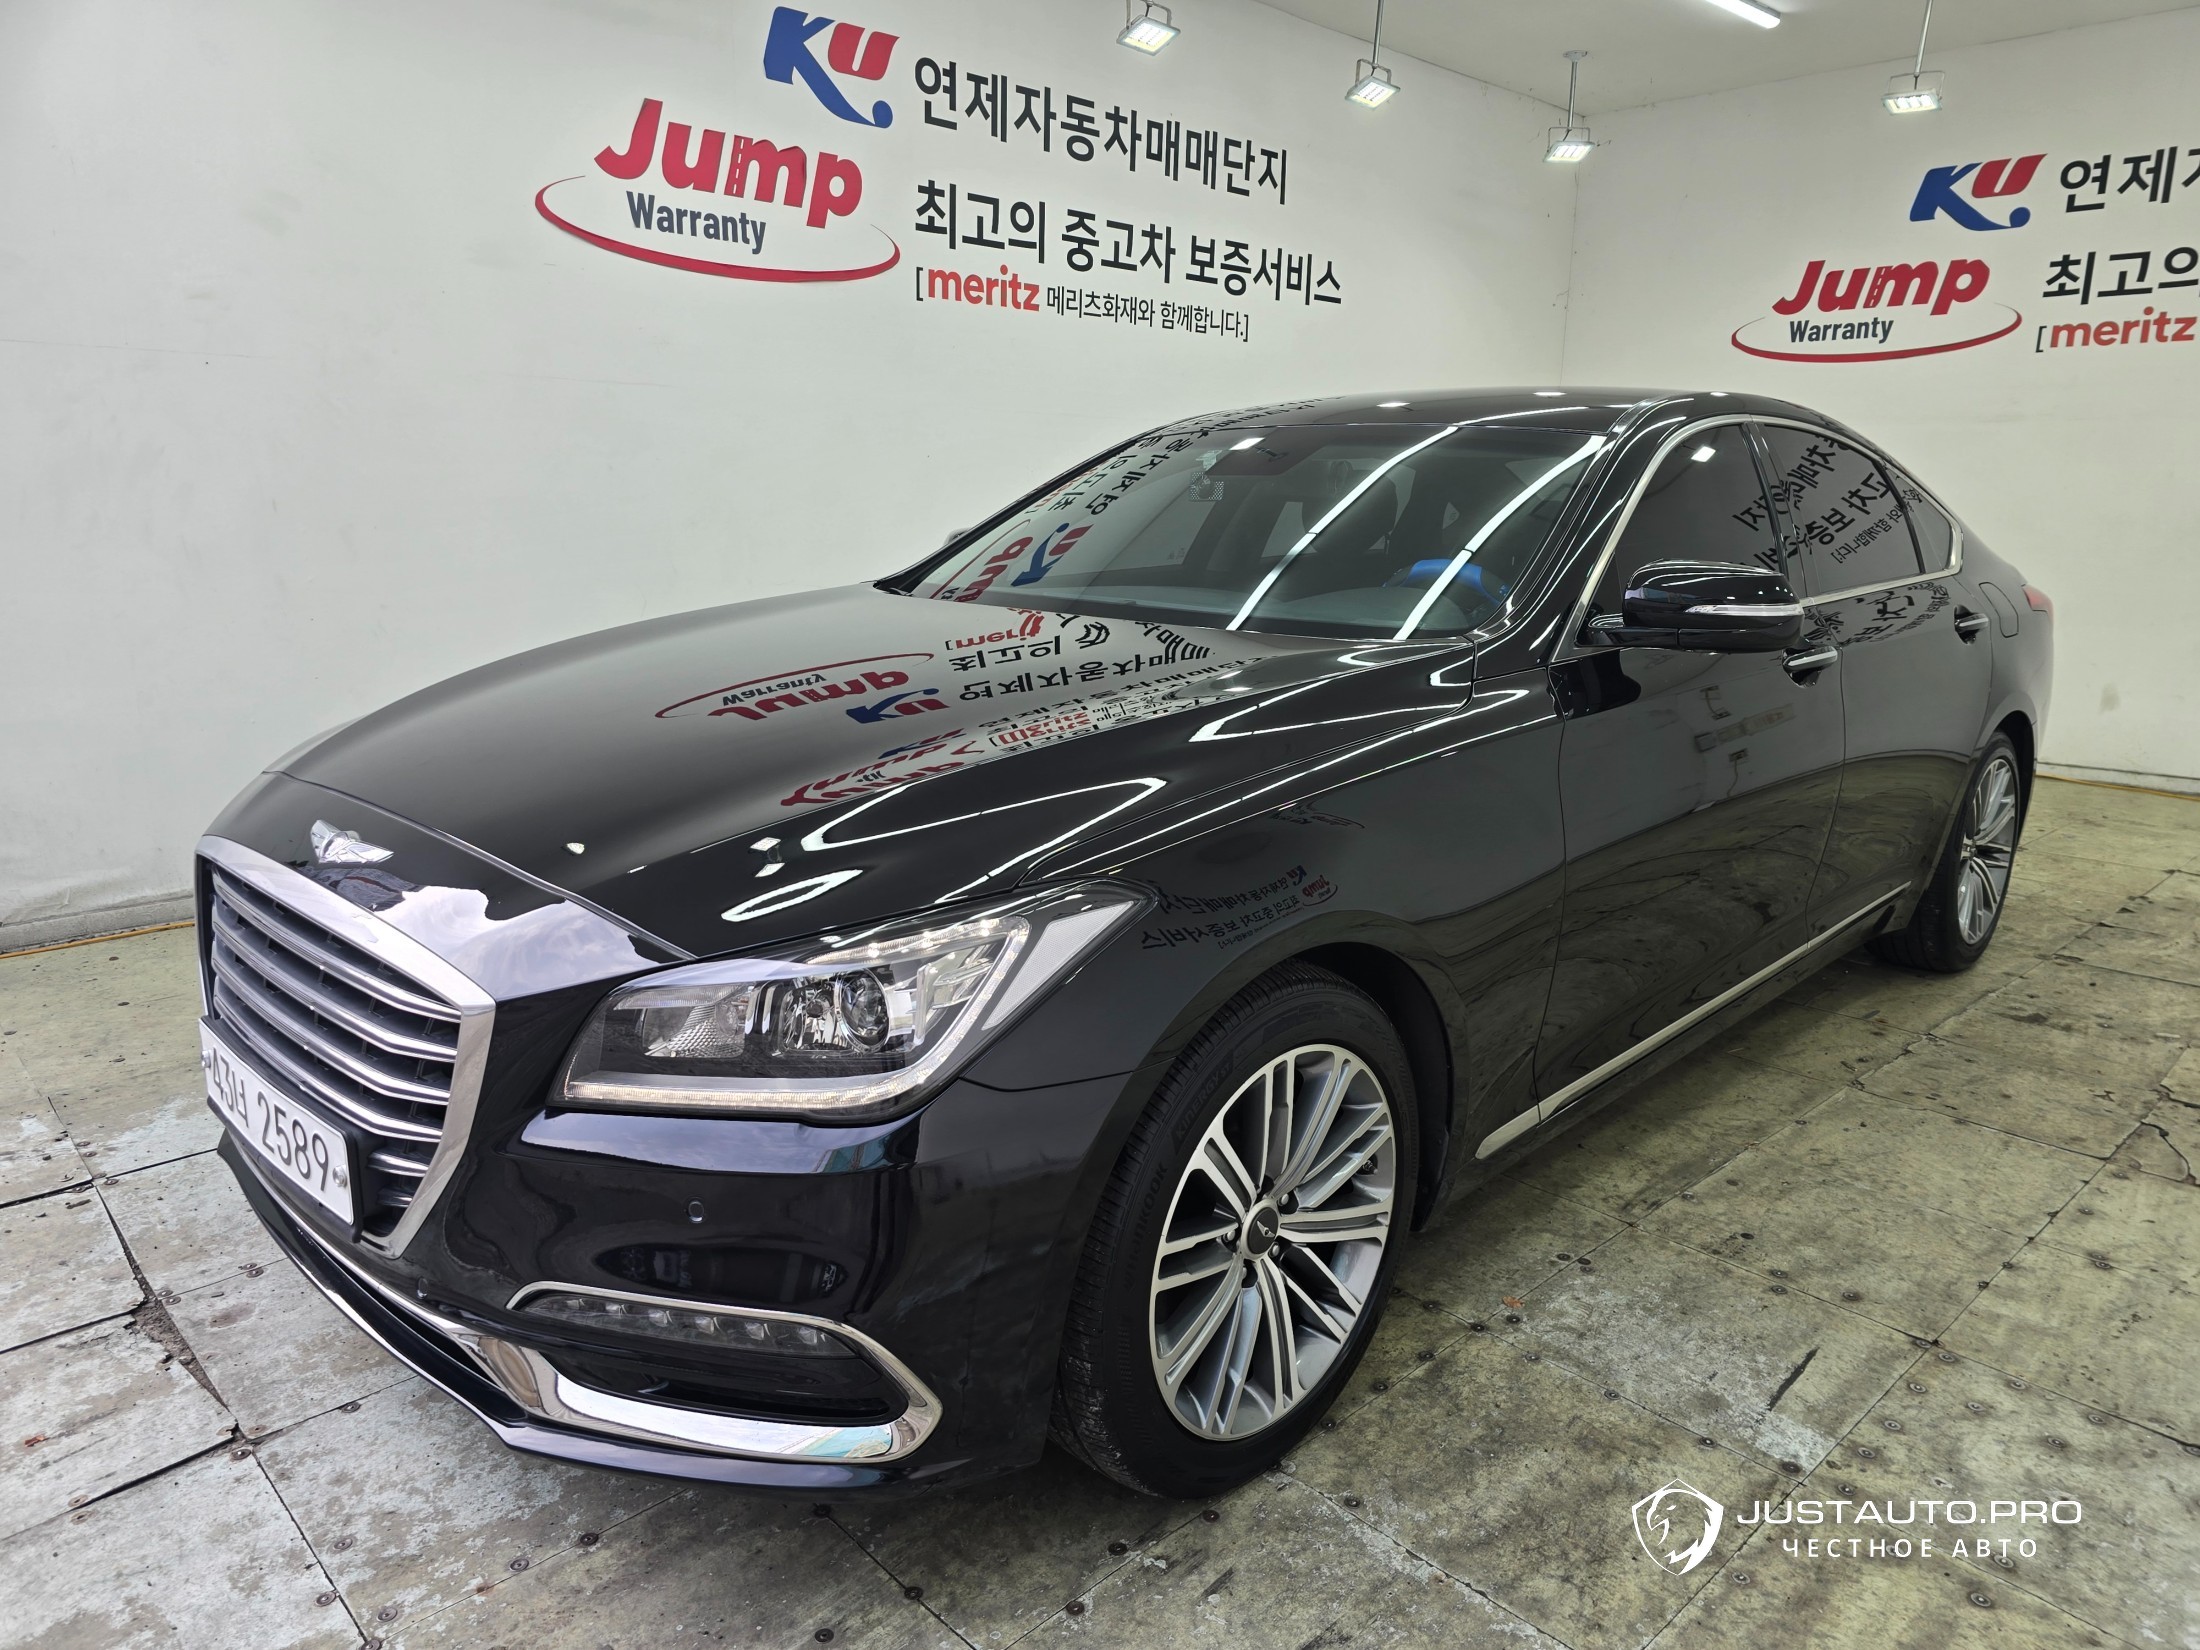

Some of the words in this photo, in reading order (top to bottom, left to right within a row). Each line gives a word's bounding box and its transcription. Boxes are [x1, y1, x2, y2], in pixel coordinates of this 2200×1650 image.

[594, 98, 863, 229] Jump
[914, 57, 1287, 206] 연제자동차매매단지
[626, 190, 767, 255] Warranty
[914, 179, 1046, 265] 최고의
[1060, 208, 1176, 285] 중고차
[1184, 235, 1343, 306] 보증서비스
[1046, 284, 1156, 328] 메리츠화재와
[1159, 299, 1250, 343] 함께합니다.]
[1772, 259, 1990, 316] Jump
[1789, 317, 1894, 344] Warranty
[257, 1090, 330, 1192] 2589
